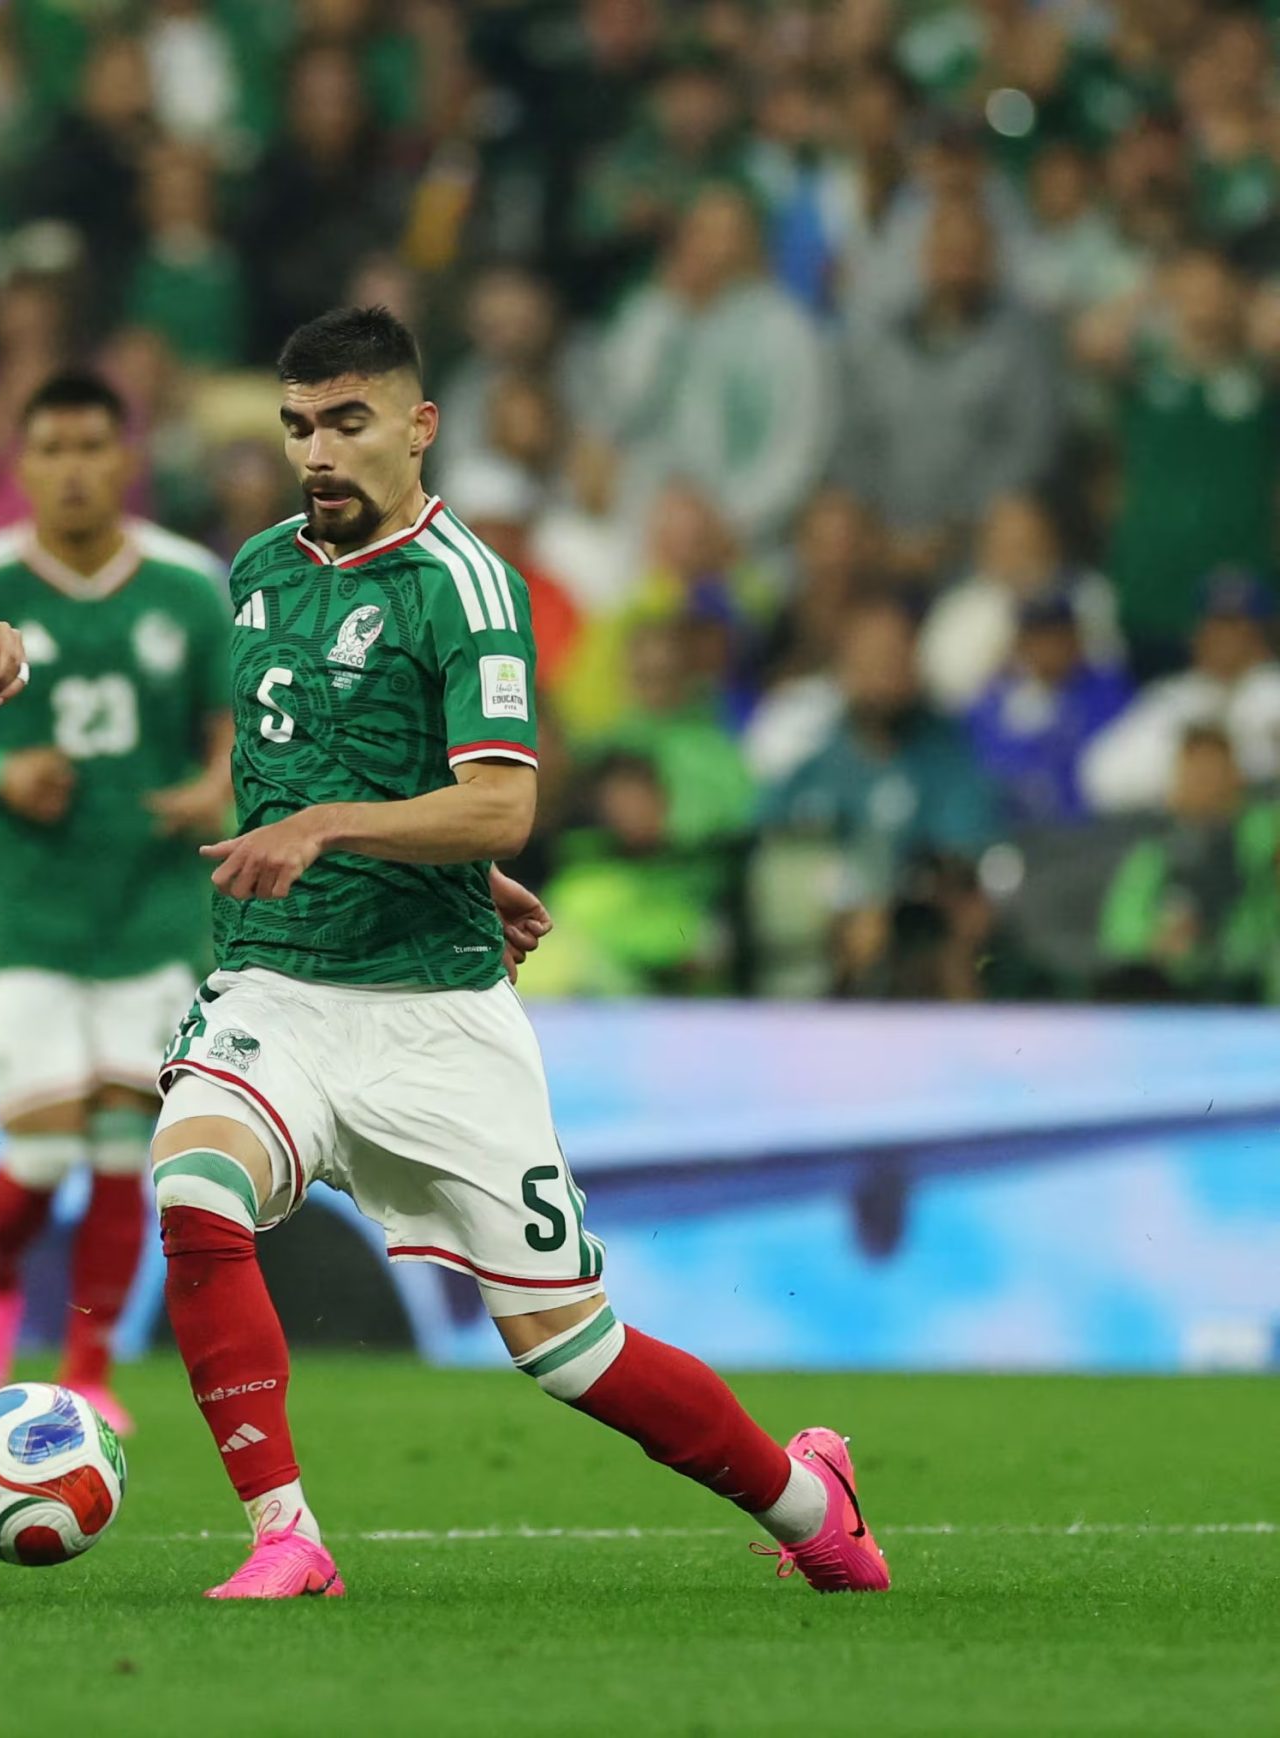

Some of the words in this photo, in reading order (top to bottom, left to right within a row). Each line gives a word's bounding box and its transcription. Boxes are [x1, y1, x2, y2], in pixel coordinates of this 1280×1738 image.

[50, 674, 138, 758] 23
[257, 667, 294, 743] 5
[521, 1164, 566, 1252] 5
